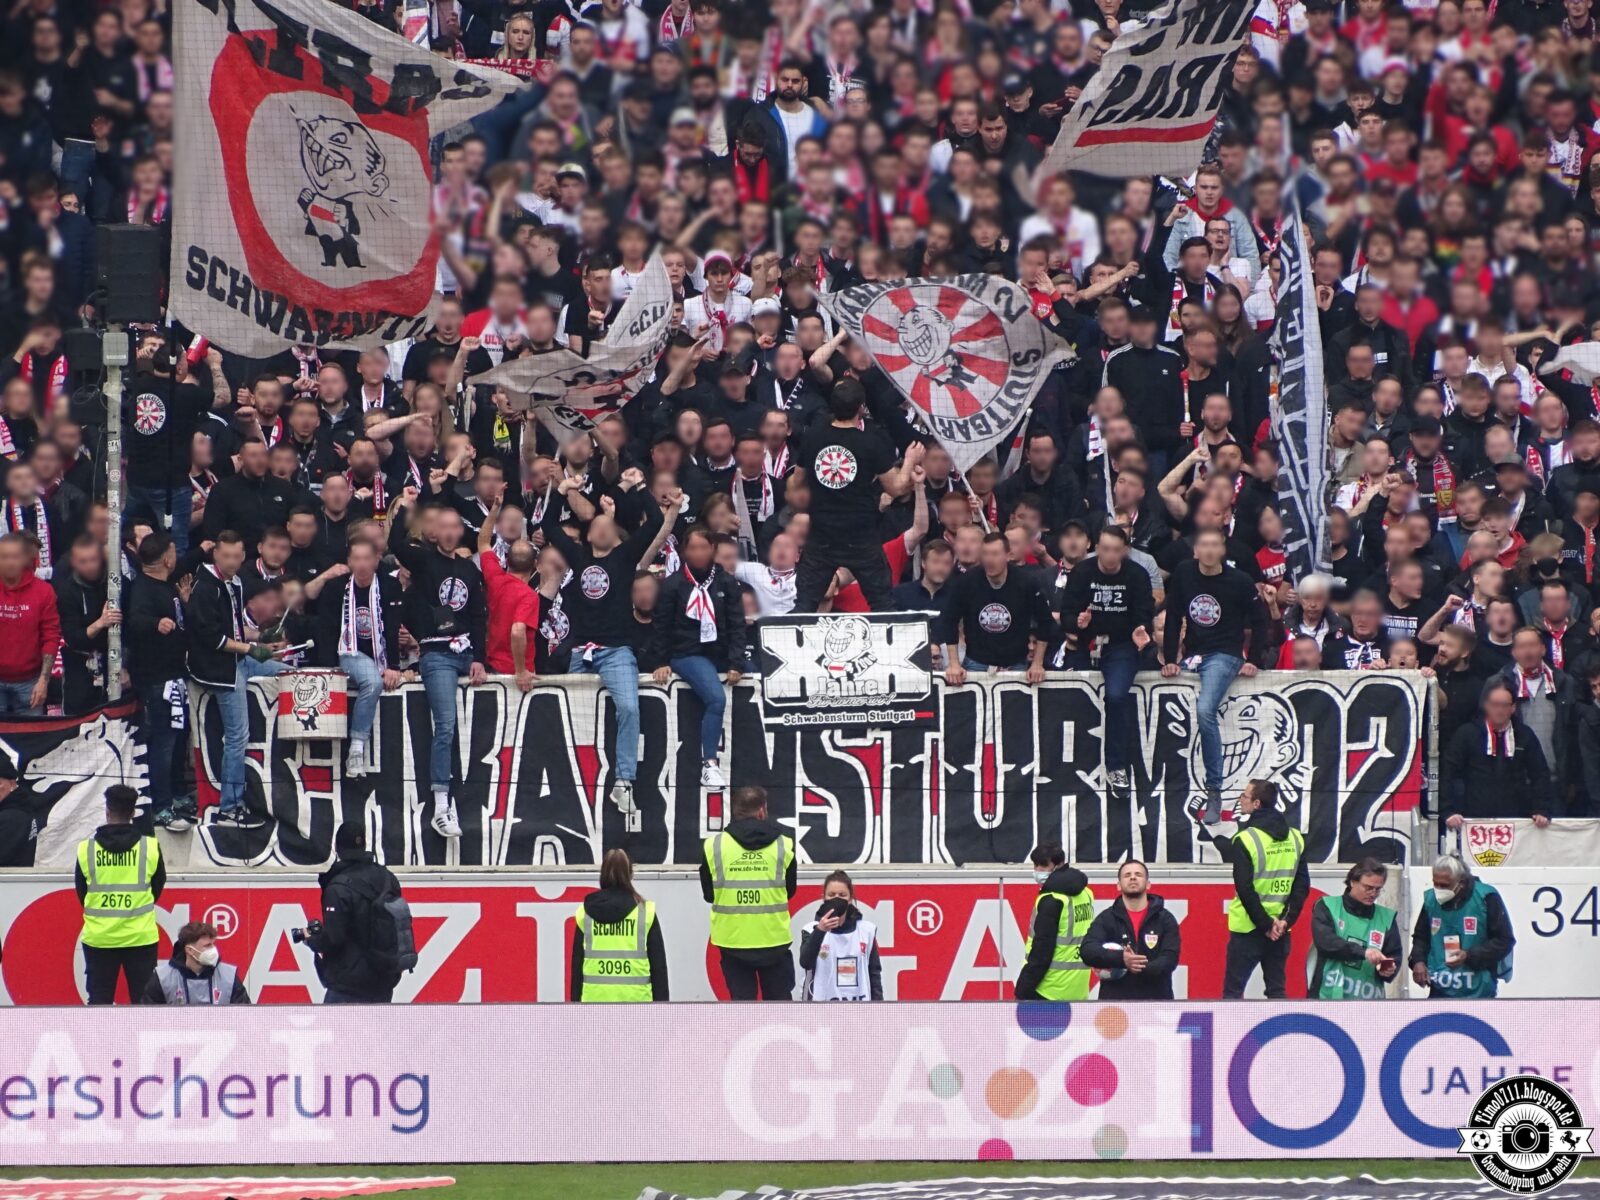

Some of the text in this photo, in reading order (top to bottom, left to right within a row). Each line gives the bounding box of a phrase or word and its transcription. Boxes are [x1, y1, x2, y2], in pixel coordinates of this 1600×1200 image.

[784, 710, 916, 724] Schwabensturm Stuttgart
[741, 851, 763, 860] SDS
[100, 893, 132, 908] 2676
[736, 890, 761, 905] 0590
[598, 960, 632, 974] 3096
